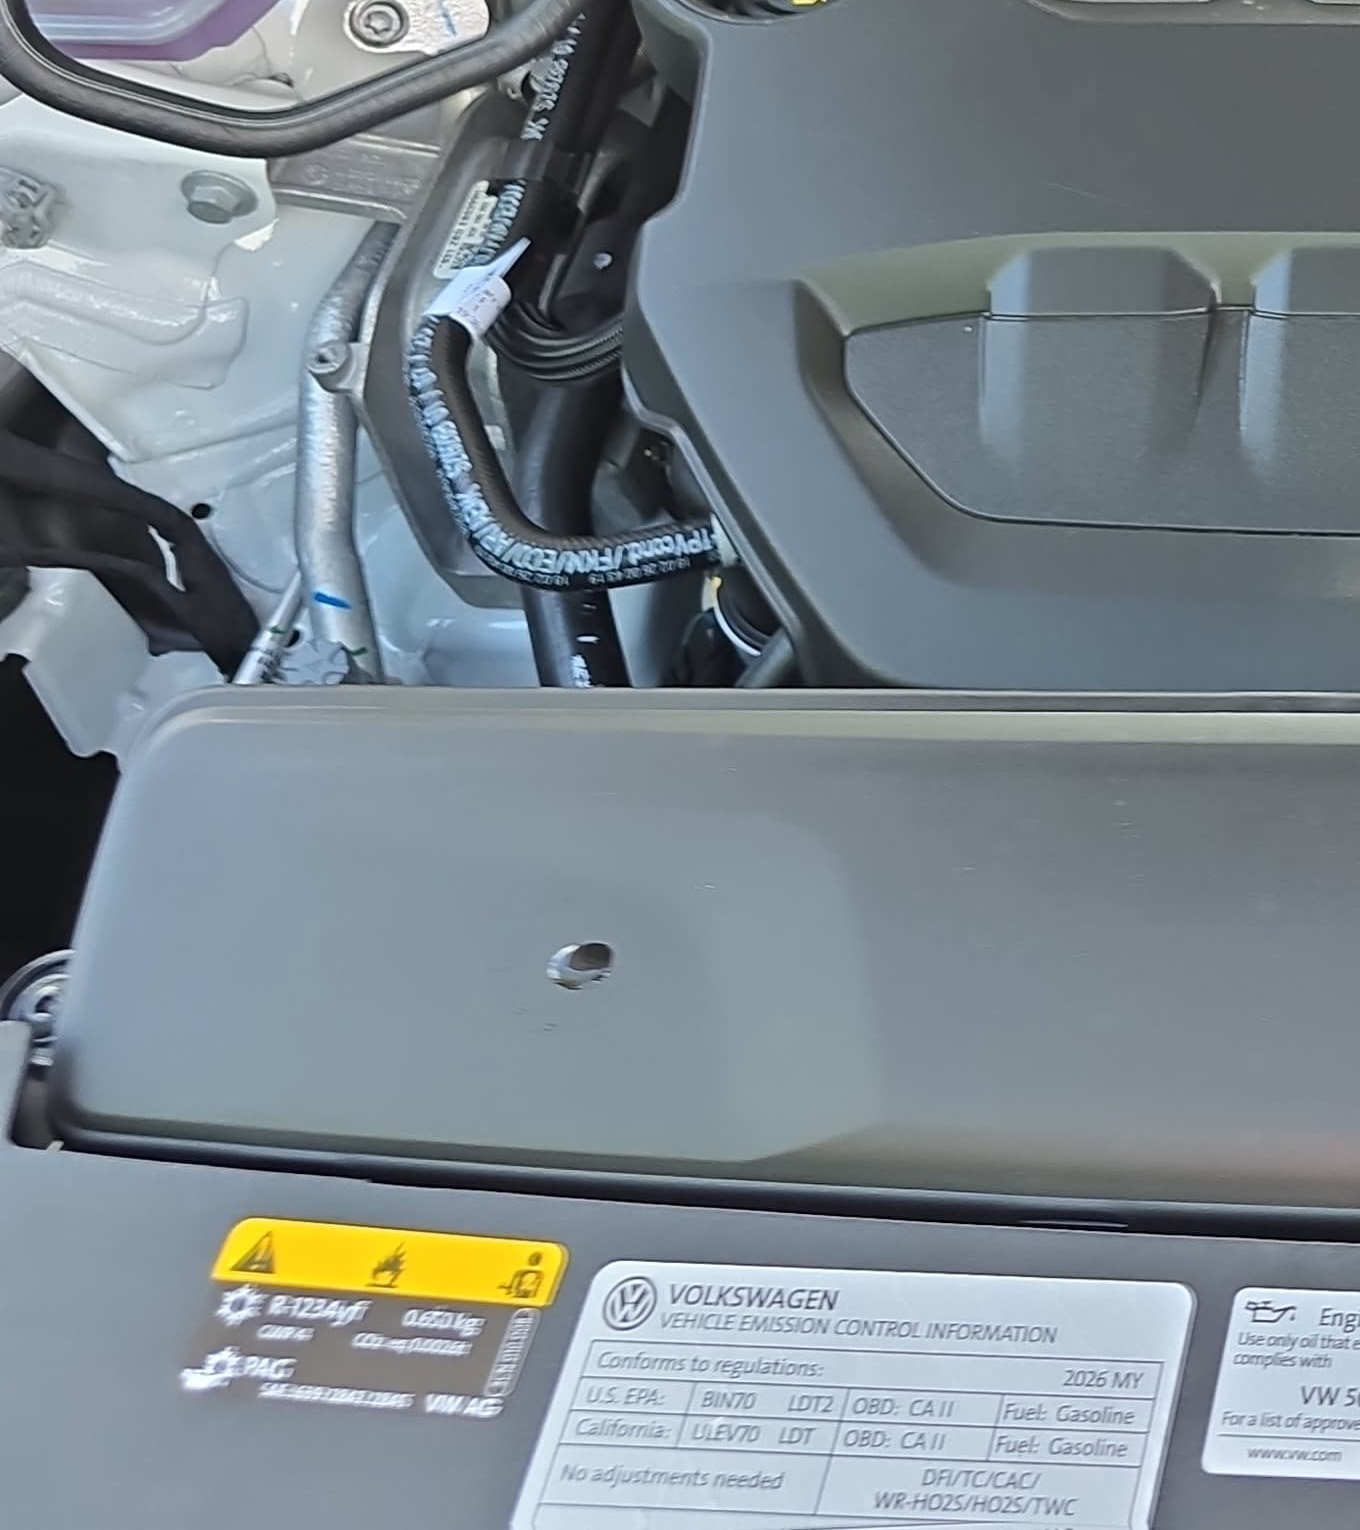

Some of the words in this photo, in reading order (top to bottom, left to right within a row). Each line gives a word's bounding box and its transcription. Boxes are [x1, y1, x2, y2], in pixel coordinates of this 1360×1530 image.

[670, 1284, 839, 1311] VOLKSWAGEN
[661, 1312, 735, 1331] VEHICLE
[739, 1316, 828, 1336] EMISSION
[833, 1319, 922, 1339] CONTROL
[926, 1323, 1059, 1344] INFORMATION
[1237, 1331, 1267, 1347] Use
[1267, 1333, 1300, 1352] only
[1300, 1333, 1318, 1349] oil
[1319, 1334, 1351, 1350] that
[597, 1351, 685, 1371] Conforms
[690, 1356, 711, 1372] to
[714, 1357, 824, 1380] regulations:
[1063, 1370, 1107, 1388] 2026
[1112, 1372, 1145, 1390] MY
[1233, 1351, 1298, 1370] complies
[1299, 1353, 1334, 1369] with
[586, 1386, 619, 1405] U.S.
[623, 1388, 665, 1406] EPA:
[701, 1391, 757, 1410] BIN70
[788, 1394, 834, 1413] LDT2
[852, 1397, 900, 1417] OBD:
[908, 1399, 938, 1418] CA
[1002, 1402, 1047, 1421] Fuel:
[1055, 1405, 1136, 1425] Gasoline
[1300, 1385, 1342, 1407] VW
[1221, 1411, 1248, 1427] For
[1249, 1414, 1258, 1427] a
[1259, 1412, 1284, 1428] list
[1285, 1413, 1304, 1429] of
[575, 1417, 672, 1440] California:
[692, 1423, 760, 1443] ULEV70
[778, 1426, 817, 1445] LDT
[843, 1429, 892, 1449] OBD:
[899, 1431, 930, 1450] CA
[995, 1435, 1041, 1454] Fuel:
[1047, 1437, 1129, 1458] Gasoline
[560, 1463, 586, 1482] No
[591, 1467, 709, 1490] adjustments
[712, 1471, 785, 1490] needed
